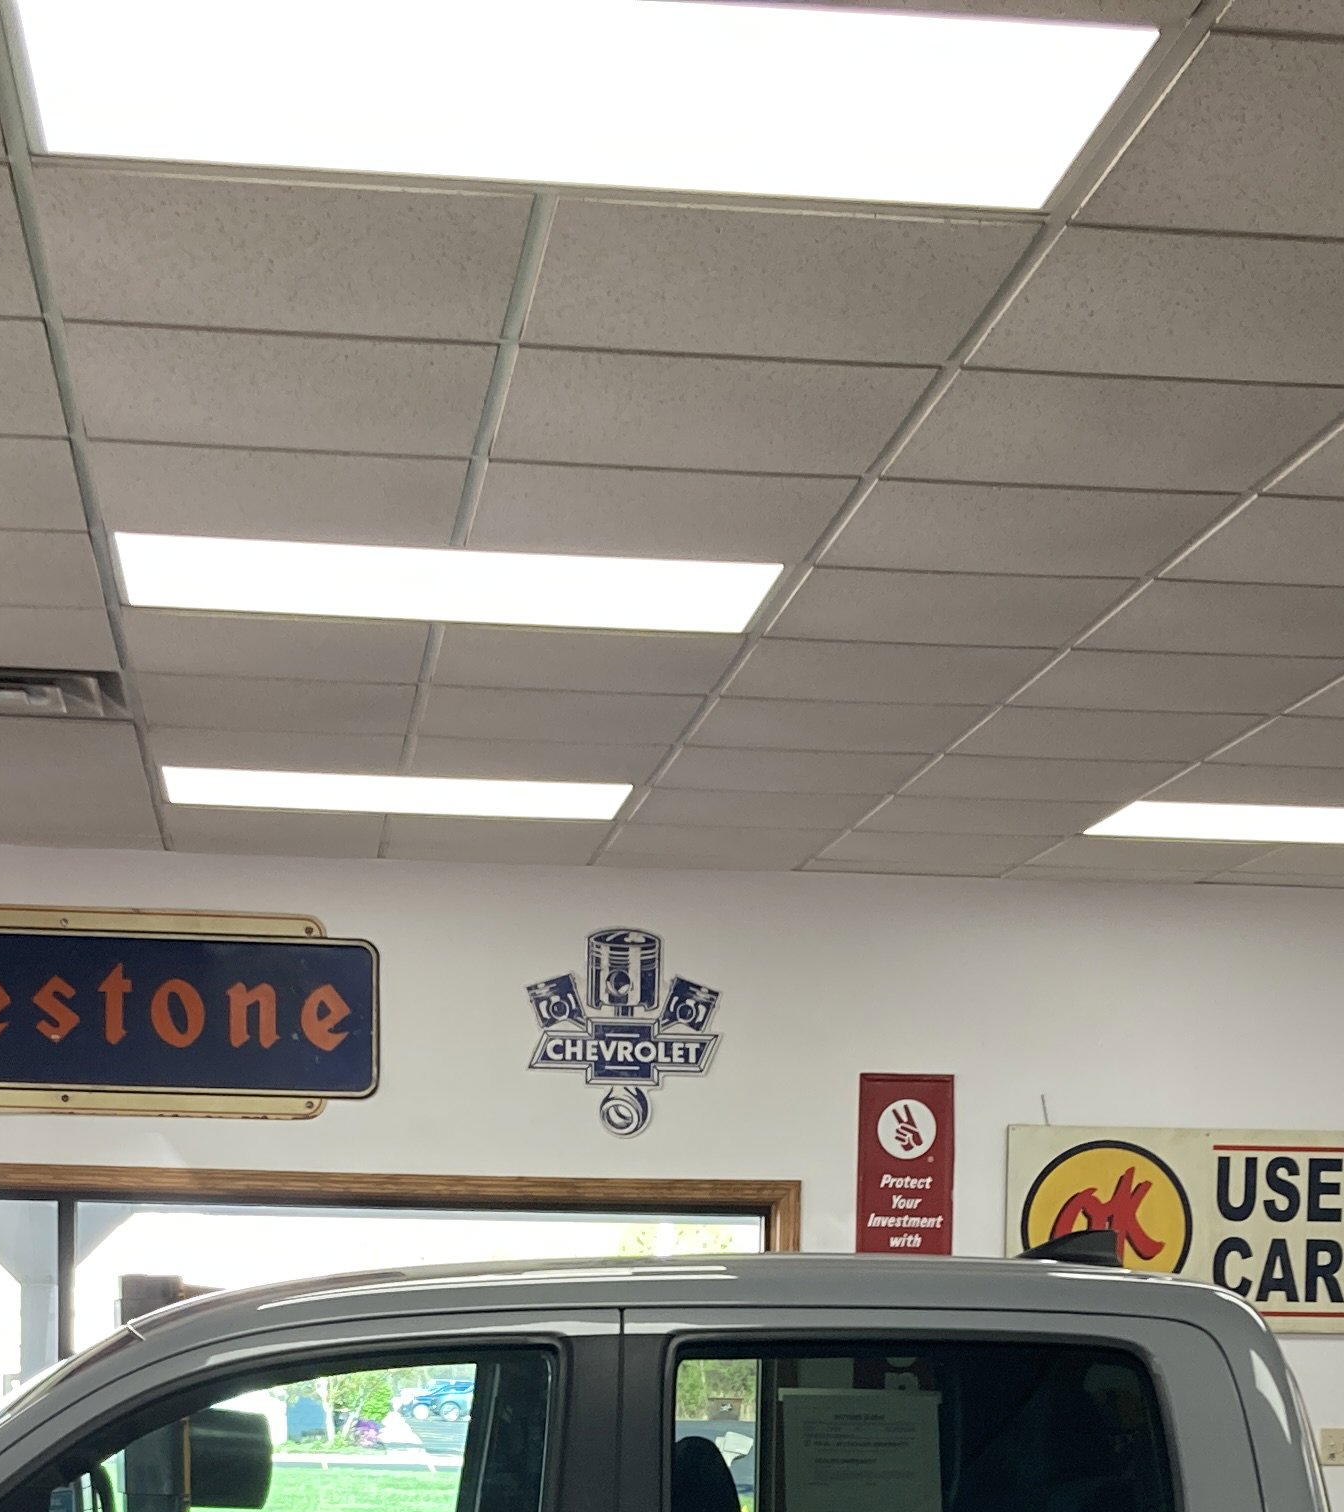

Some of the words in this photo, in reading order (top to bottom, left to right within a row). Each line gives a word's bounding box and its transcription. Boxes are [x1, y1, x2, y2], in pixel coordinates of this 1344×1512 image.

[546, 1039, 701, 1064] CHEVROLET
[880, 1174, 933, 1189] Protect
[891, 1195, 922, 1209] Your
[867, 1213, 944, 1228] Investment
[889, 1233, 922, 1248] with
